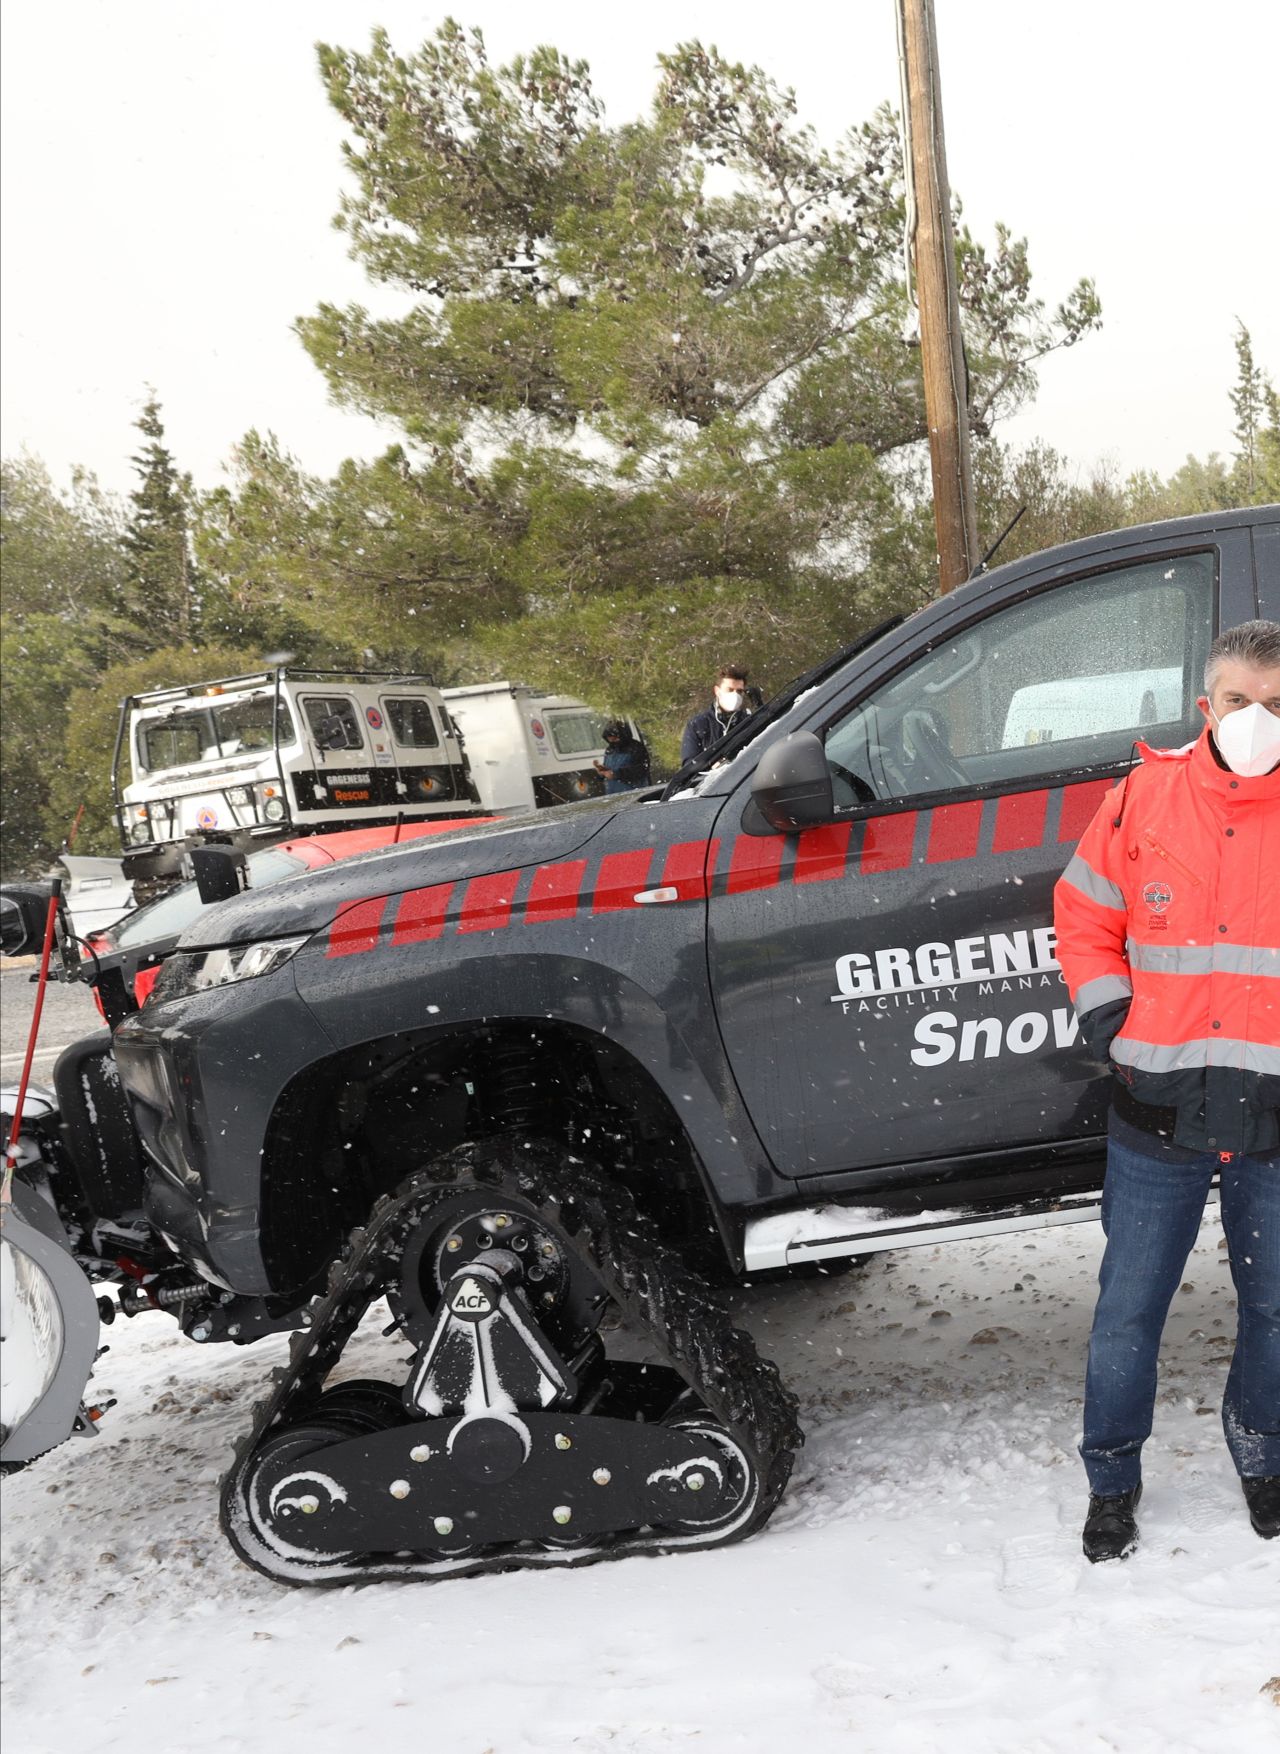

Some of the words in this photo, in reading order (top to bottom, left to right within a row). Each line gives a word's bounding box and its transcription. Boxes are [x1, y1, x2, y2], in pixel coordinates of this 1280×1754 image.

[834, 926, 1062, 996] GRGENE
[842, 986, 958, 1015] FACILITY
[455, 1295, 488, 1309] ACF
